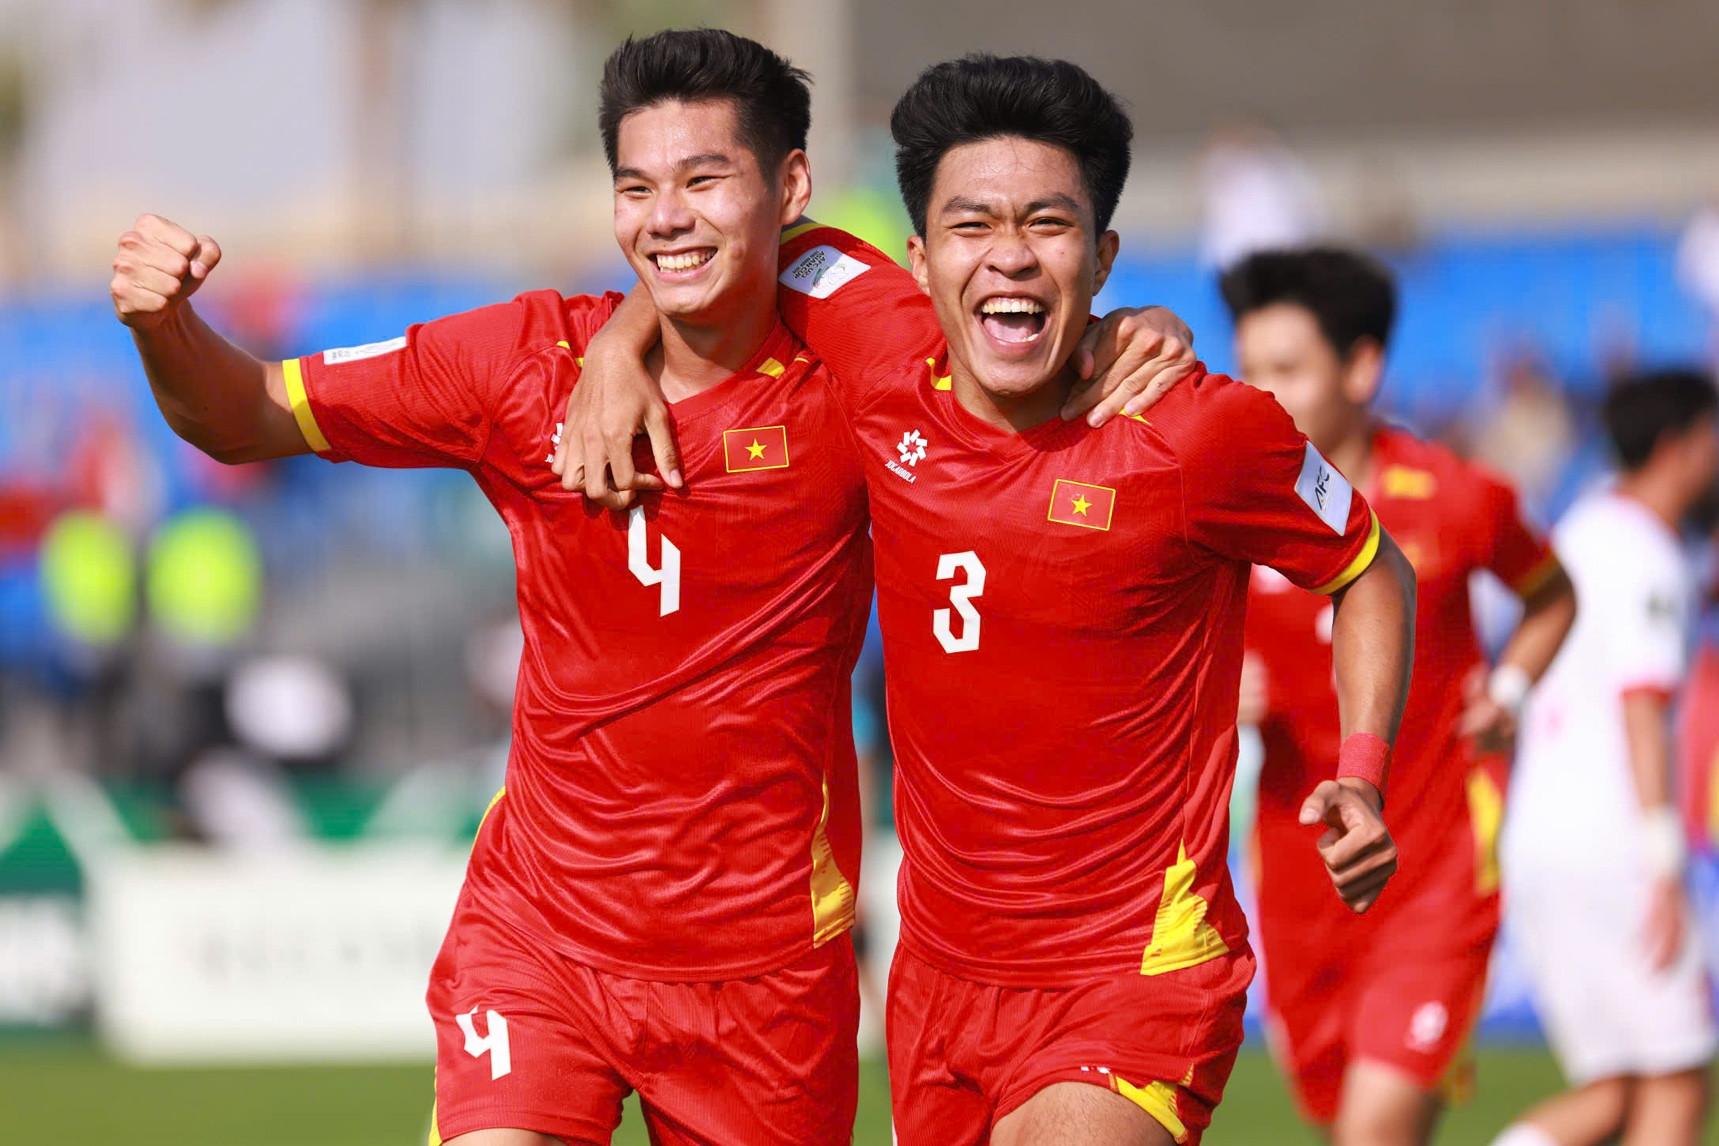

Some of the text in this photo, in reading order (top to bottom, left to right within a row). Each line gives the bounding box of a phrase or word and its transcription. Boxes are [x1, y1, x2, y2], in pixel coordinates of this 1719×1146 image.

[805, 250, 824, 268] ASIAN
[1314, 465, 1330, 510] AFC
[628, 505, 681, 617] 4
[933, 550, 987, 654] 3
[456, 1005, 512, 1081] 4
